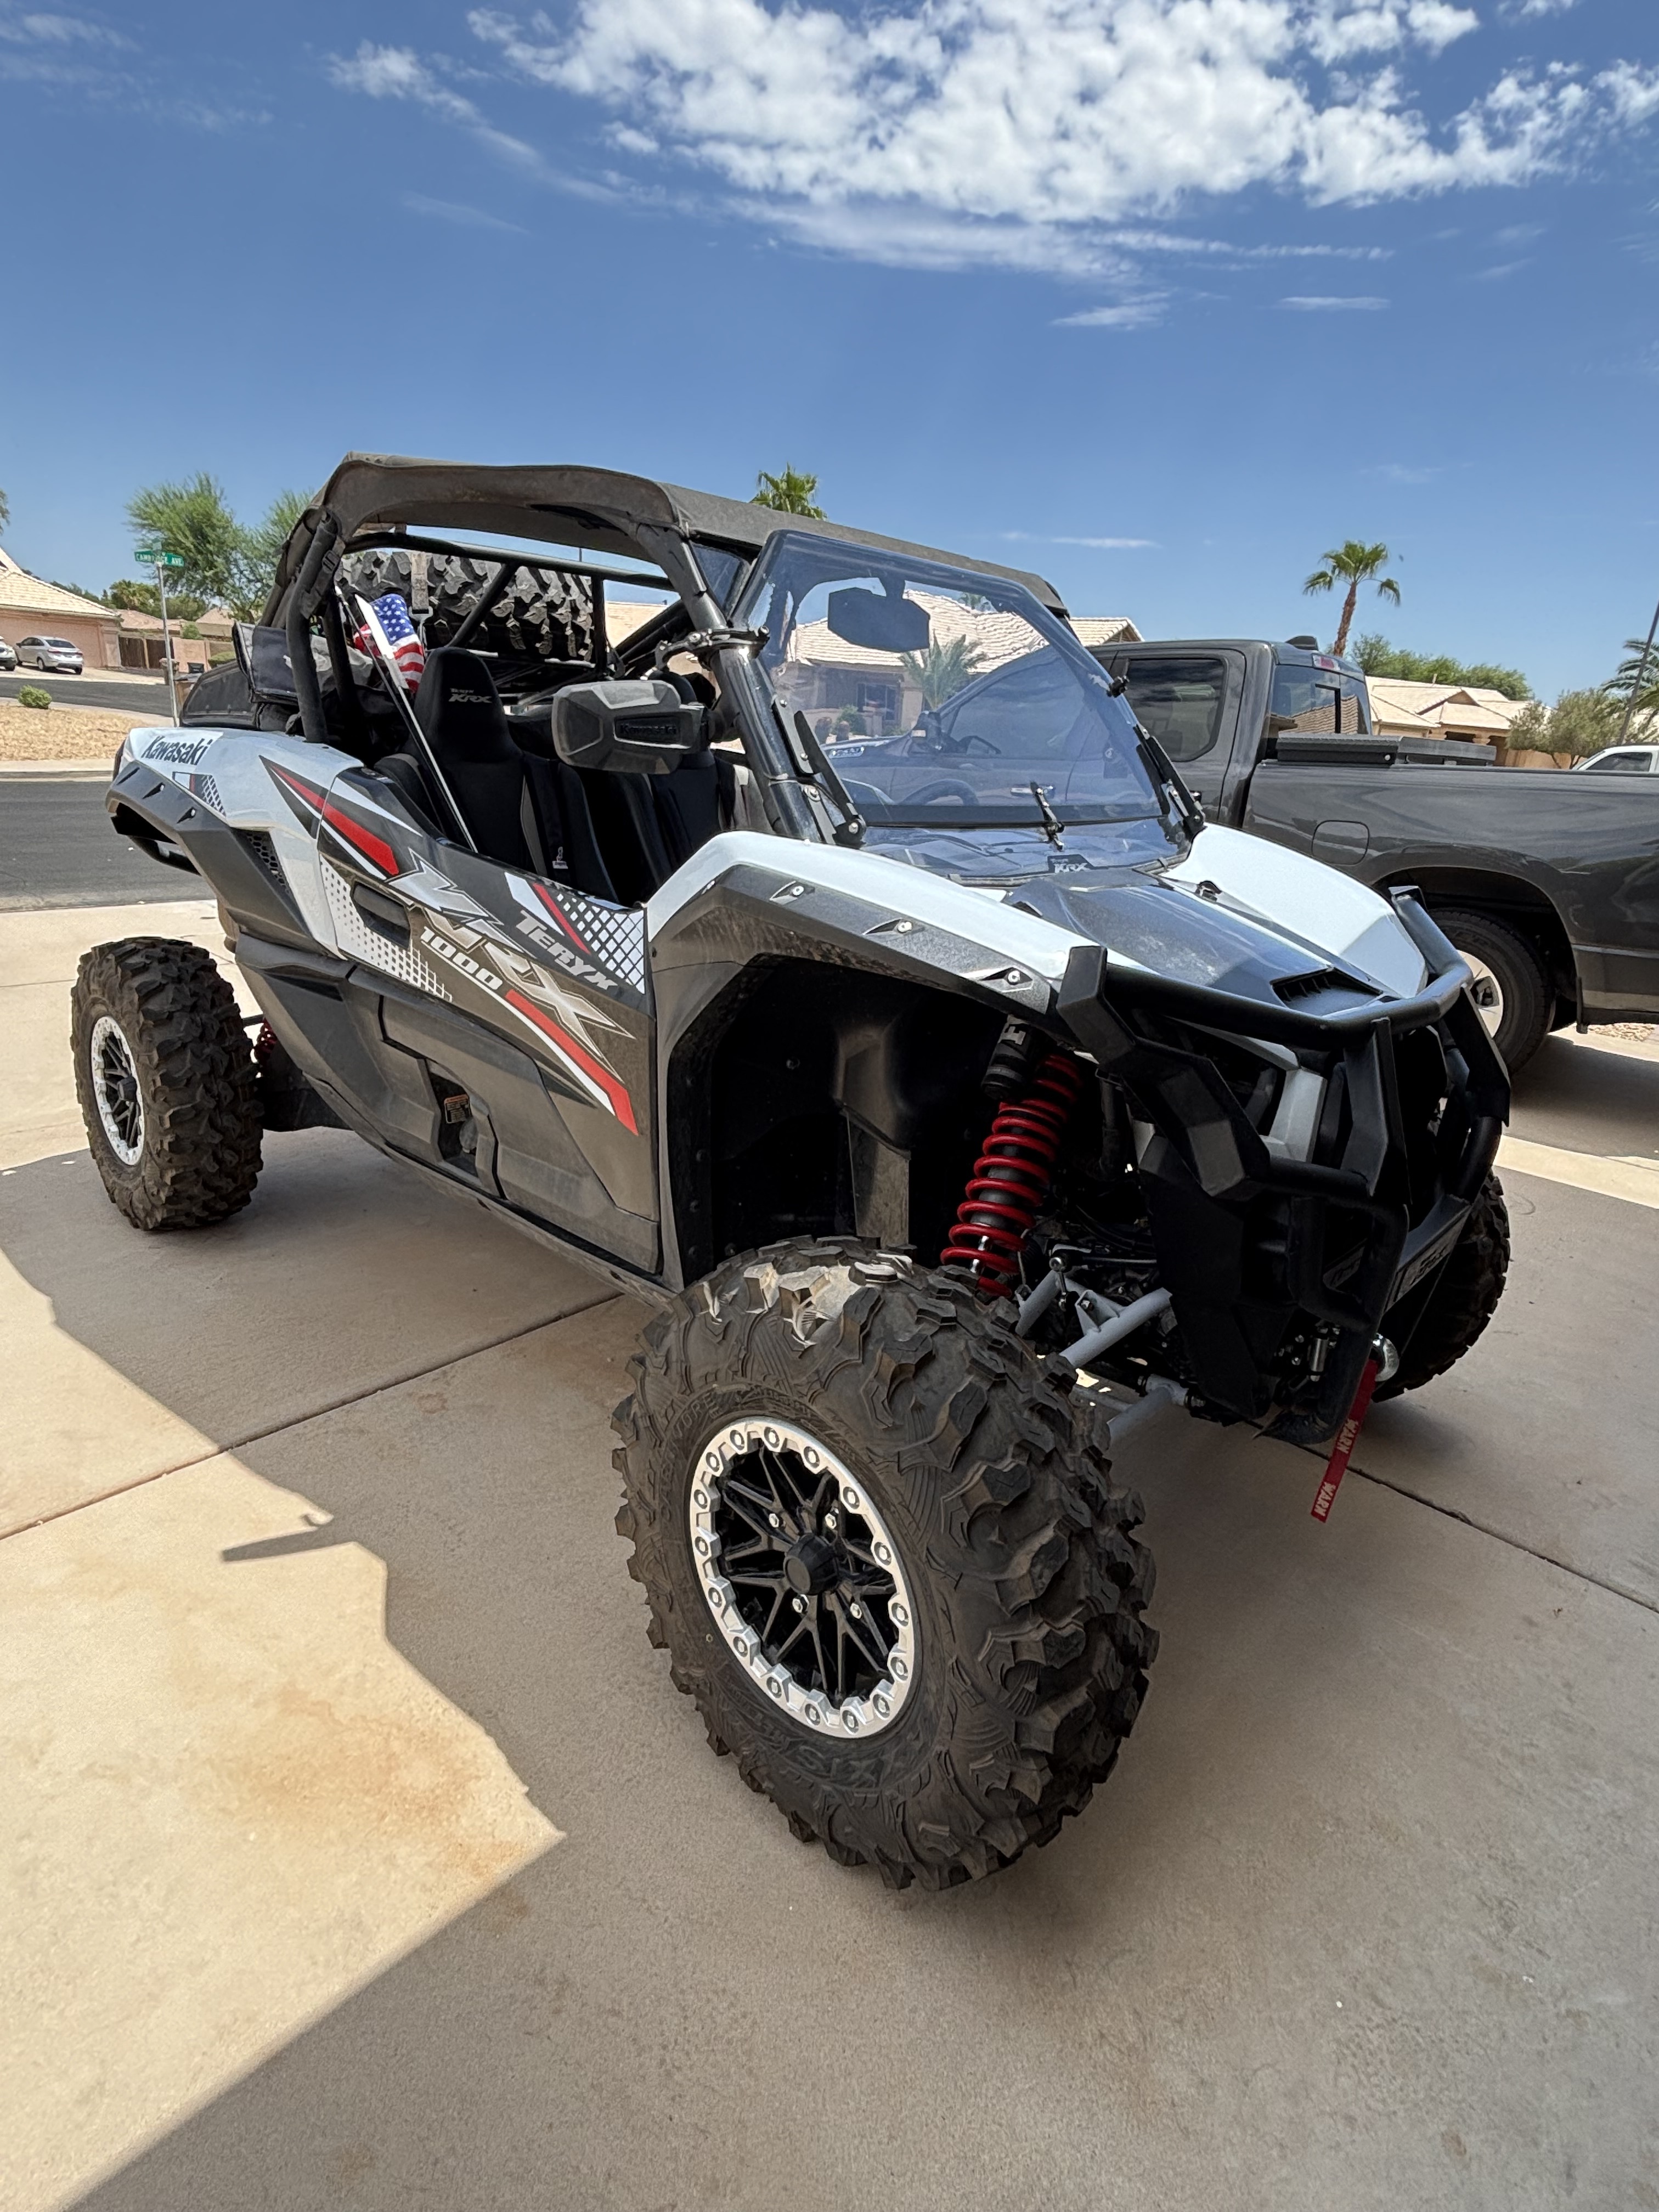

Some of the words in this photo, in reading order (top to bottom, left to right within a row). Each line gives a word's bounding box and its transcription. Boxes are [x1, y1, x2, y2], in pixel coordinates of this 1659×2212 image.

[448, 693, 492, 703] KRX
[140, 735, 213, 765] Kawasaki
[420, 926, 503, 991] 1000
[514, 909, 619, 991] TERYX
[1336, 1418, 1358, 1454] WARN
[1313, 1481, 1336, 1516] WARN
